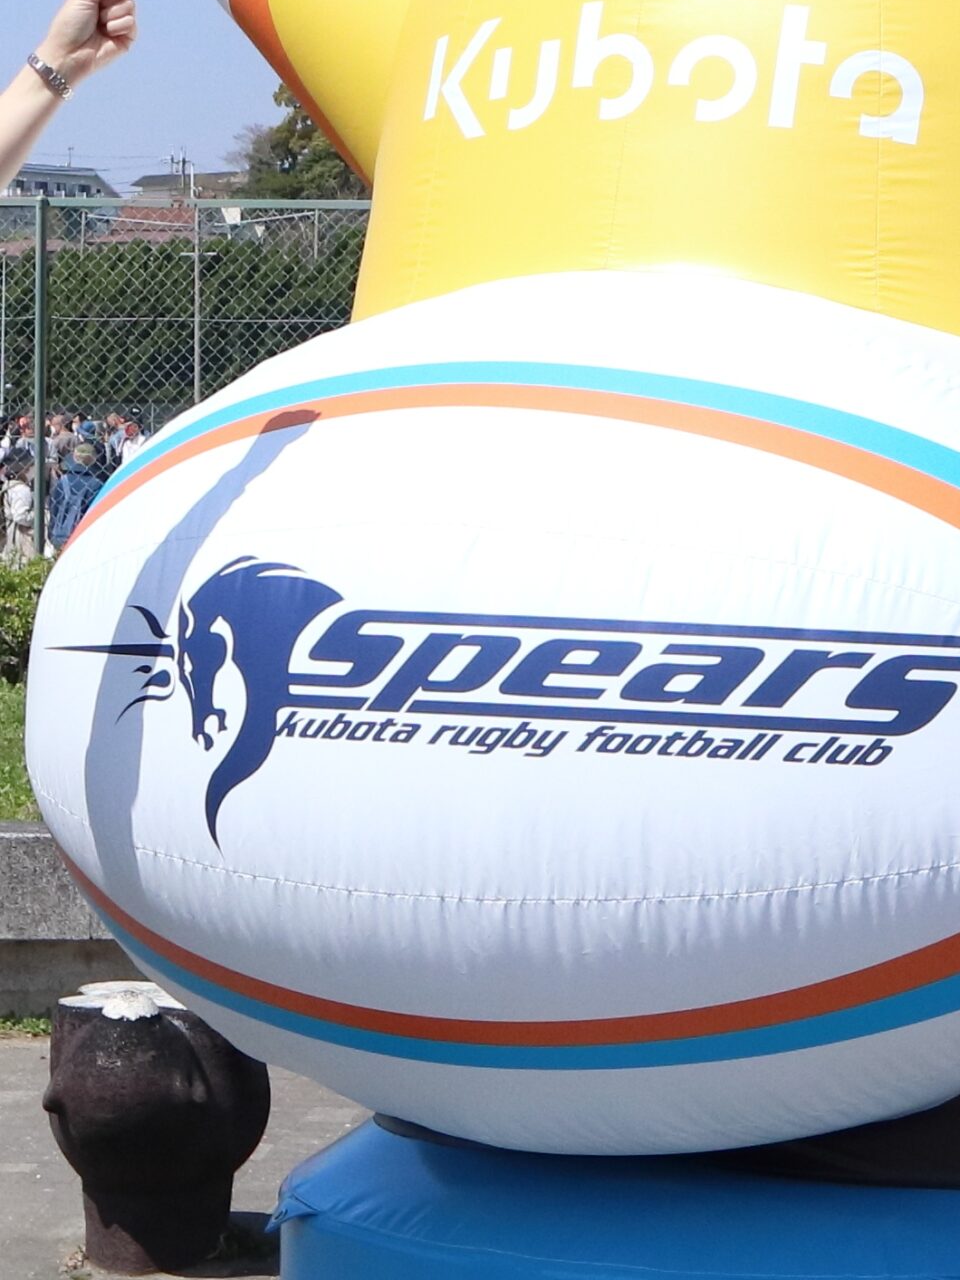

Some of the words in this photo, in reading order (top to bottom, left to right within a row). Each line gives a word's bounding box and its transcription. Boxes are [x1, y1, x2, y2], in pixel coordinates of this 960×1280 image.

[423, 0, 925, 145] Kubota
[275, 711, 421, 744] kubota
[427, 722, 570, 757] rugby
[575, 725, 783, 760] football
[782, 737, 893, 766] club
